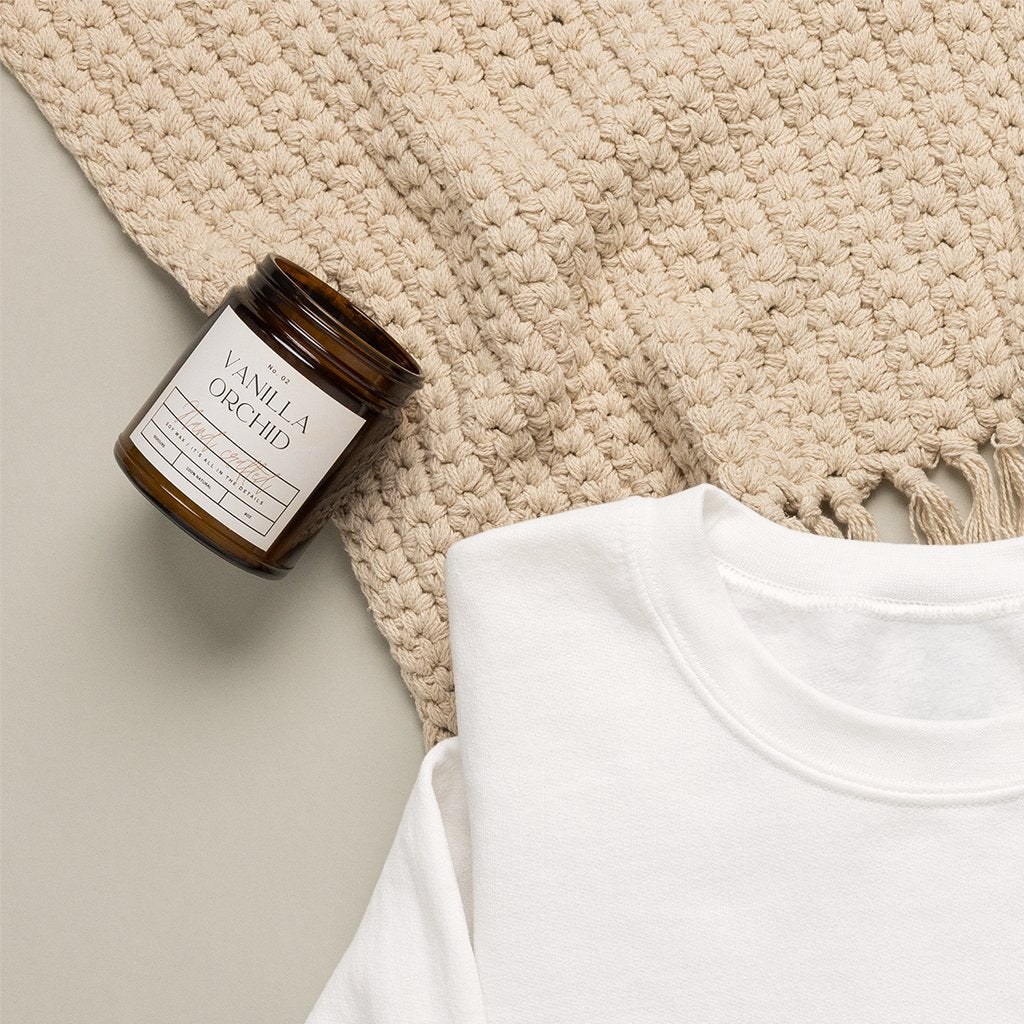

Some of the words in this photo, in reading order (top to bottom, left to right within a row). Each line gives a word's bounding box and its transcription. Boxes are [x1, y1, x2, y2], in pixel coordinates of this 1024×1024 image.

[224, 349, 309, 434] VANILLA
[267, 363, 279, 377] No.
[280, 375, 291, 385] 02
[208, 377, 291, 450] ORCHID
[238, 485, 264, 506] DETAILS
